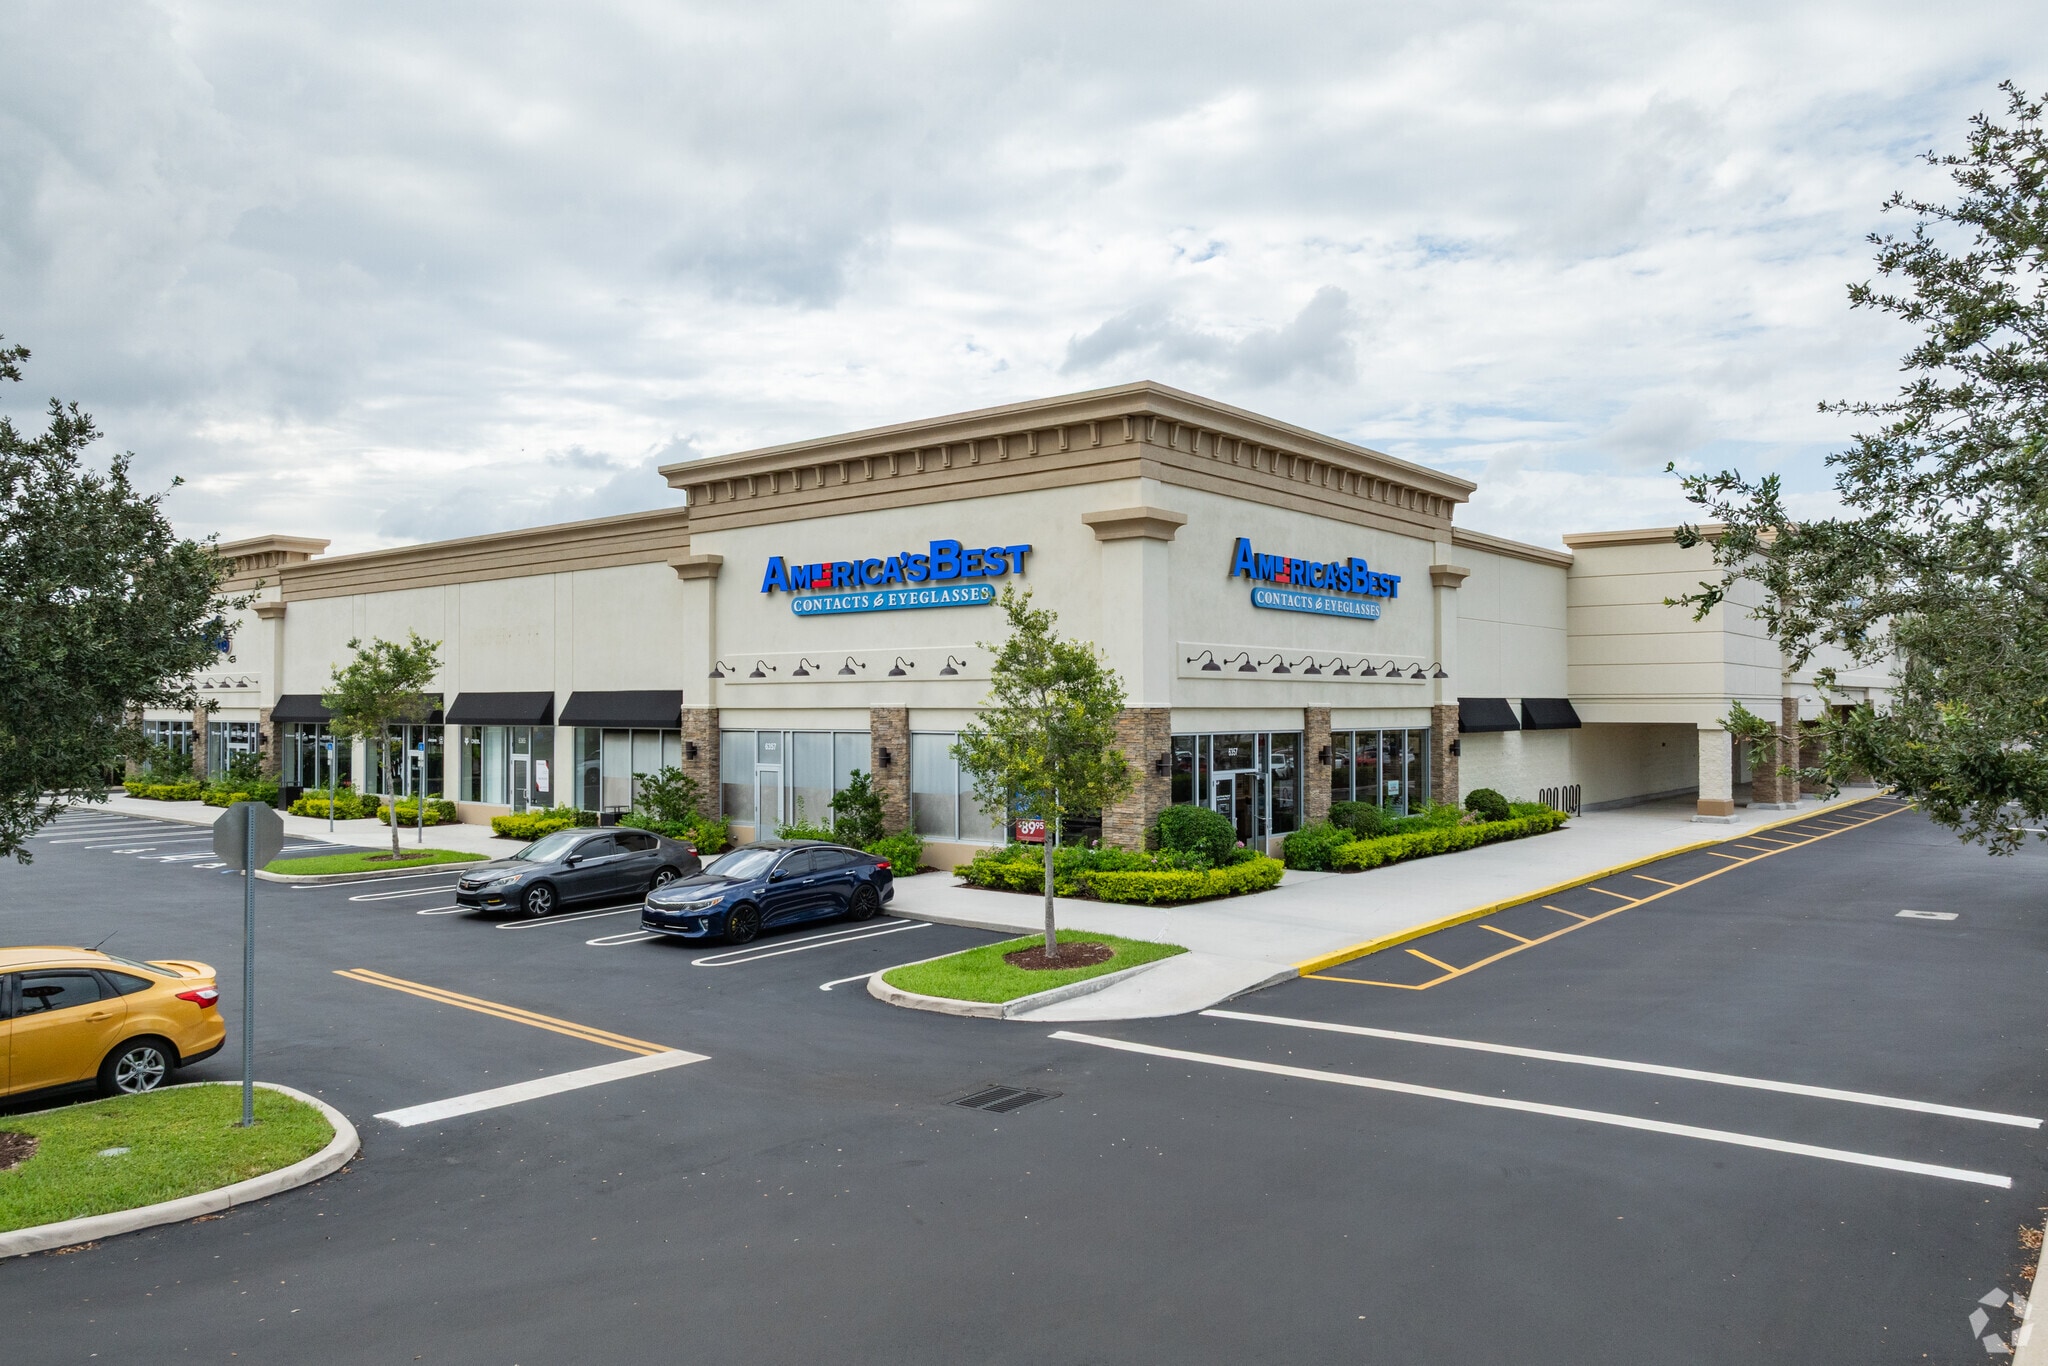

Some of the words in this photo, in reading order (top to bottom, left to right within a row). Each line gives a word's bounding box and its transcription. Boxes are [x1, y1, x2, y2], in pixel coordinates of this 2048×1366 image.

[793, 596, 870, 612] CONTACTS
[888, 586, 990, 606] EYEGLASSES
[1257, 590, 1313, 609] CONTACTS
[1324, 598, 1380, 617] EYEGLASSES
